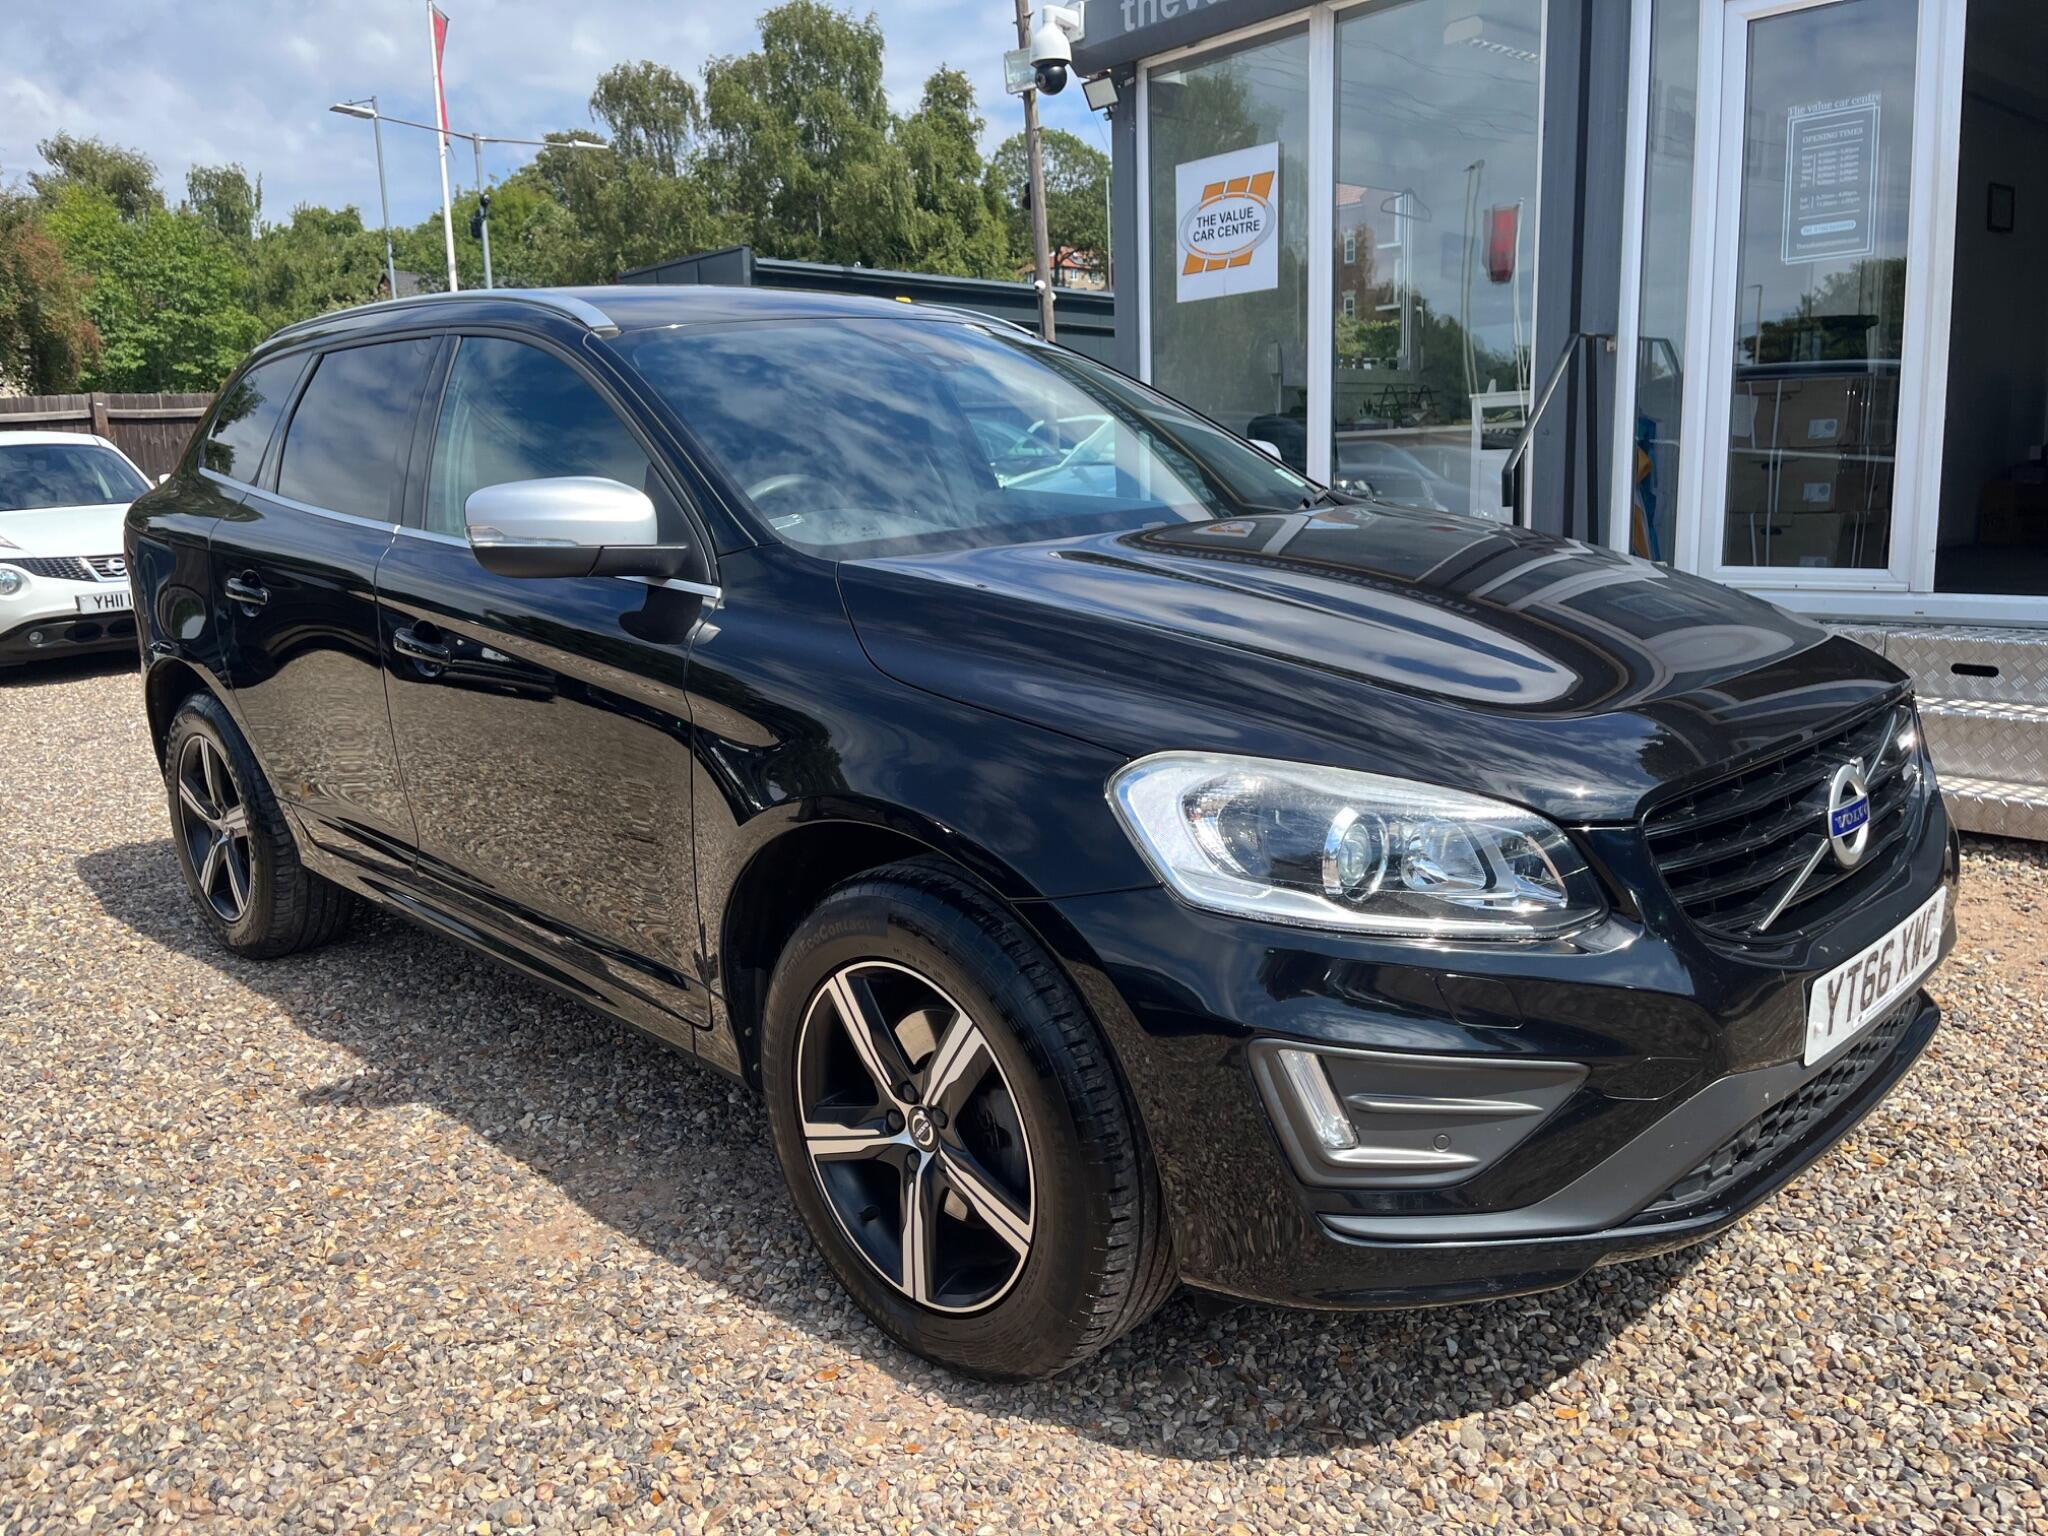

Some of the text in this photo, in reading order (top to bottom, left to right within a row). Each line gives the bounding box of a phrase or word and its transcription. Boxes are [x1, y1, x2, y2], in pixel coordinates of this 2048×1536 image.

[1834, 98, 1851, 109] car
[1802, 127, 1863, 144] OPENING TIMES
[1196, 207, 1254, 228] THE VALUE
[1193, 220, 1261, 243] CAR CENTRE
[93, 593, 124, 609] YH11
[1826, 939, 1895, 1037] YT66
